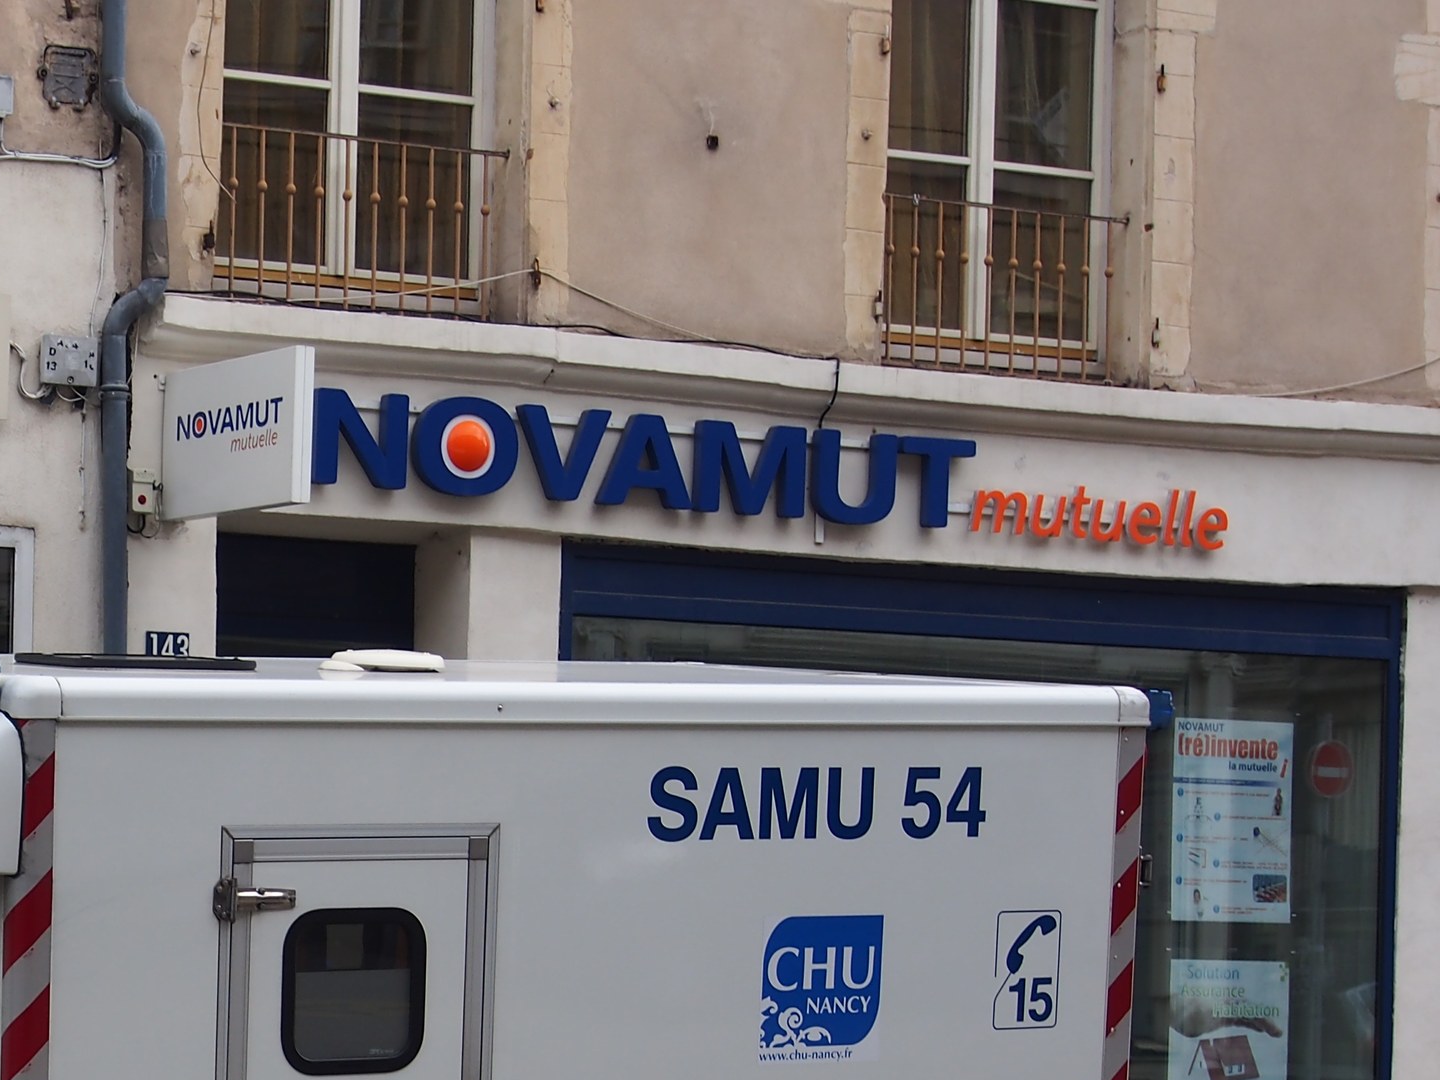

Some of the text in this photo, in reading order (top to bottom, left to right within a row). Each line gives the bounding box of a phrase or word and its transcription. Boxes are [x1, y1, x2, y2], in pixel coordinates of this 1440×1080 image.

[176, 397, 284, 442] NOVAMUT
[230, 429, 278, 453] mutuelle
[311, 386, 976, 529] NOVAMUT
[969, 485, 1229, 551] mutuelle
[150, 633, 189, 657] 143
[1178, 721, 1224, 732] NOVAMUT
[1178, 733, 1278, 760] (ré)invente
[1228, 761, 1236, 770] la
[1238, 763, 1277, 772] mutuelle
[647, 765, 987, 842] SAMU 54
[767, 945, 874, 992] CHU
[1186, 964, 1240, 980] Solution
[1008, 976, 1054, 1023] 15
[1180, 983, 1245, 998] Assurance
[806, 995, 872, 1015] NANCY
[759, 1047, 852, 1062] www.chu-nancy.fr
